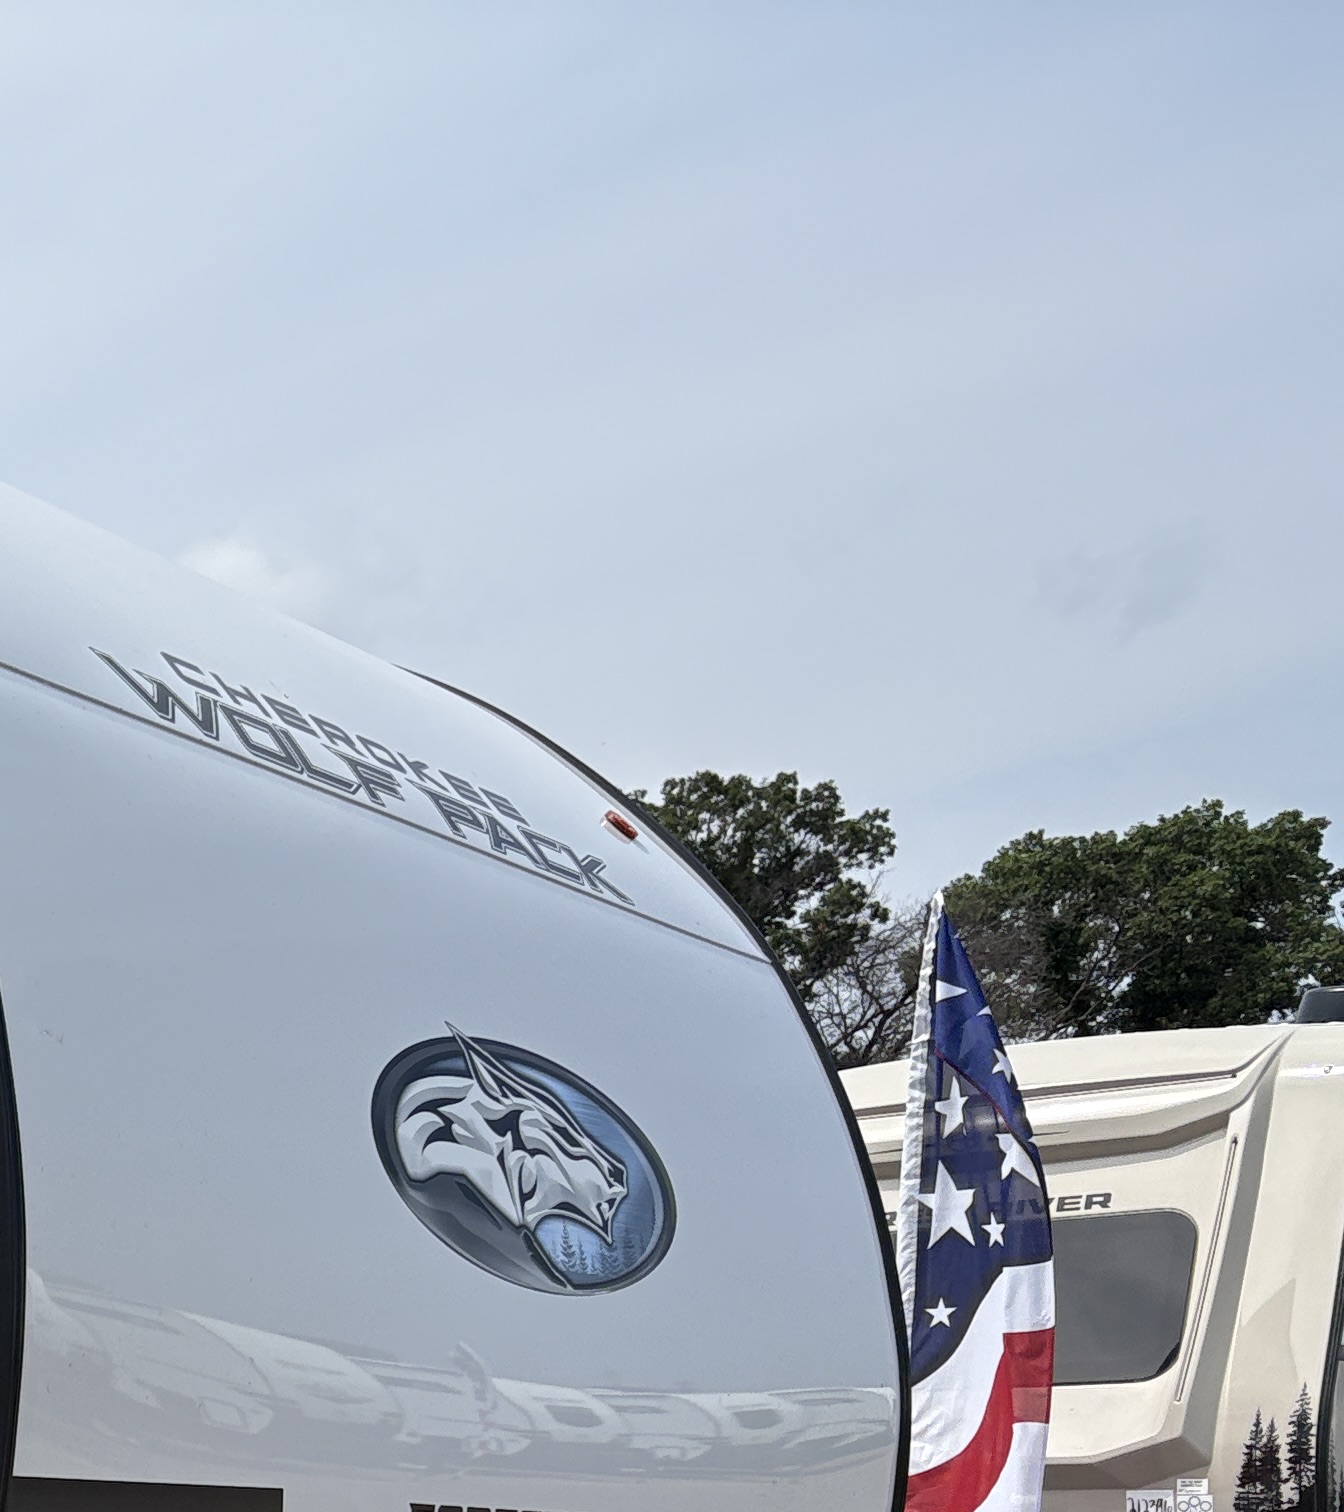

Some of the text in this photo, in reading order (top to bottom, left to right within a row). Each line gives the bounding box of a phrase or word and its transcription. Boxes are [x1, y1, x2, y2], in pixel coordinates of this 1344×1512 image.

[88, 646, 636, 907] WOLF PACK
[160, 651, 531, 827] CHEROKEE
